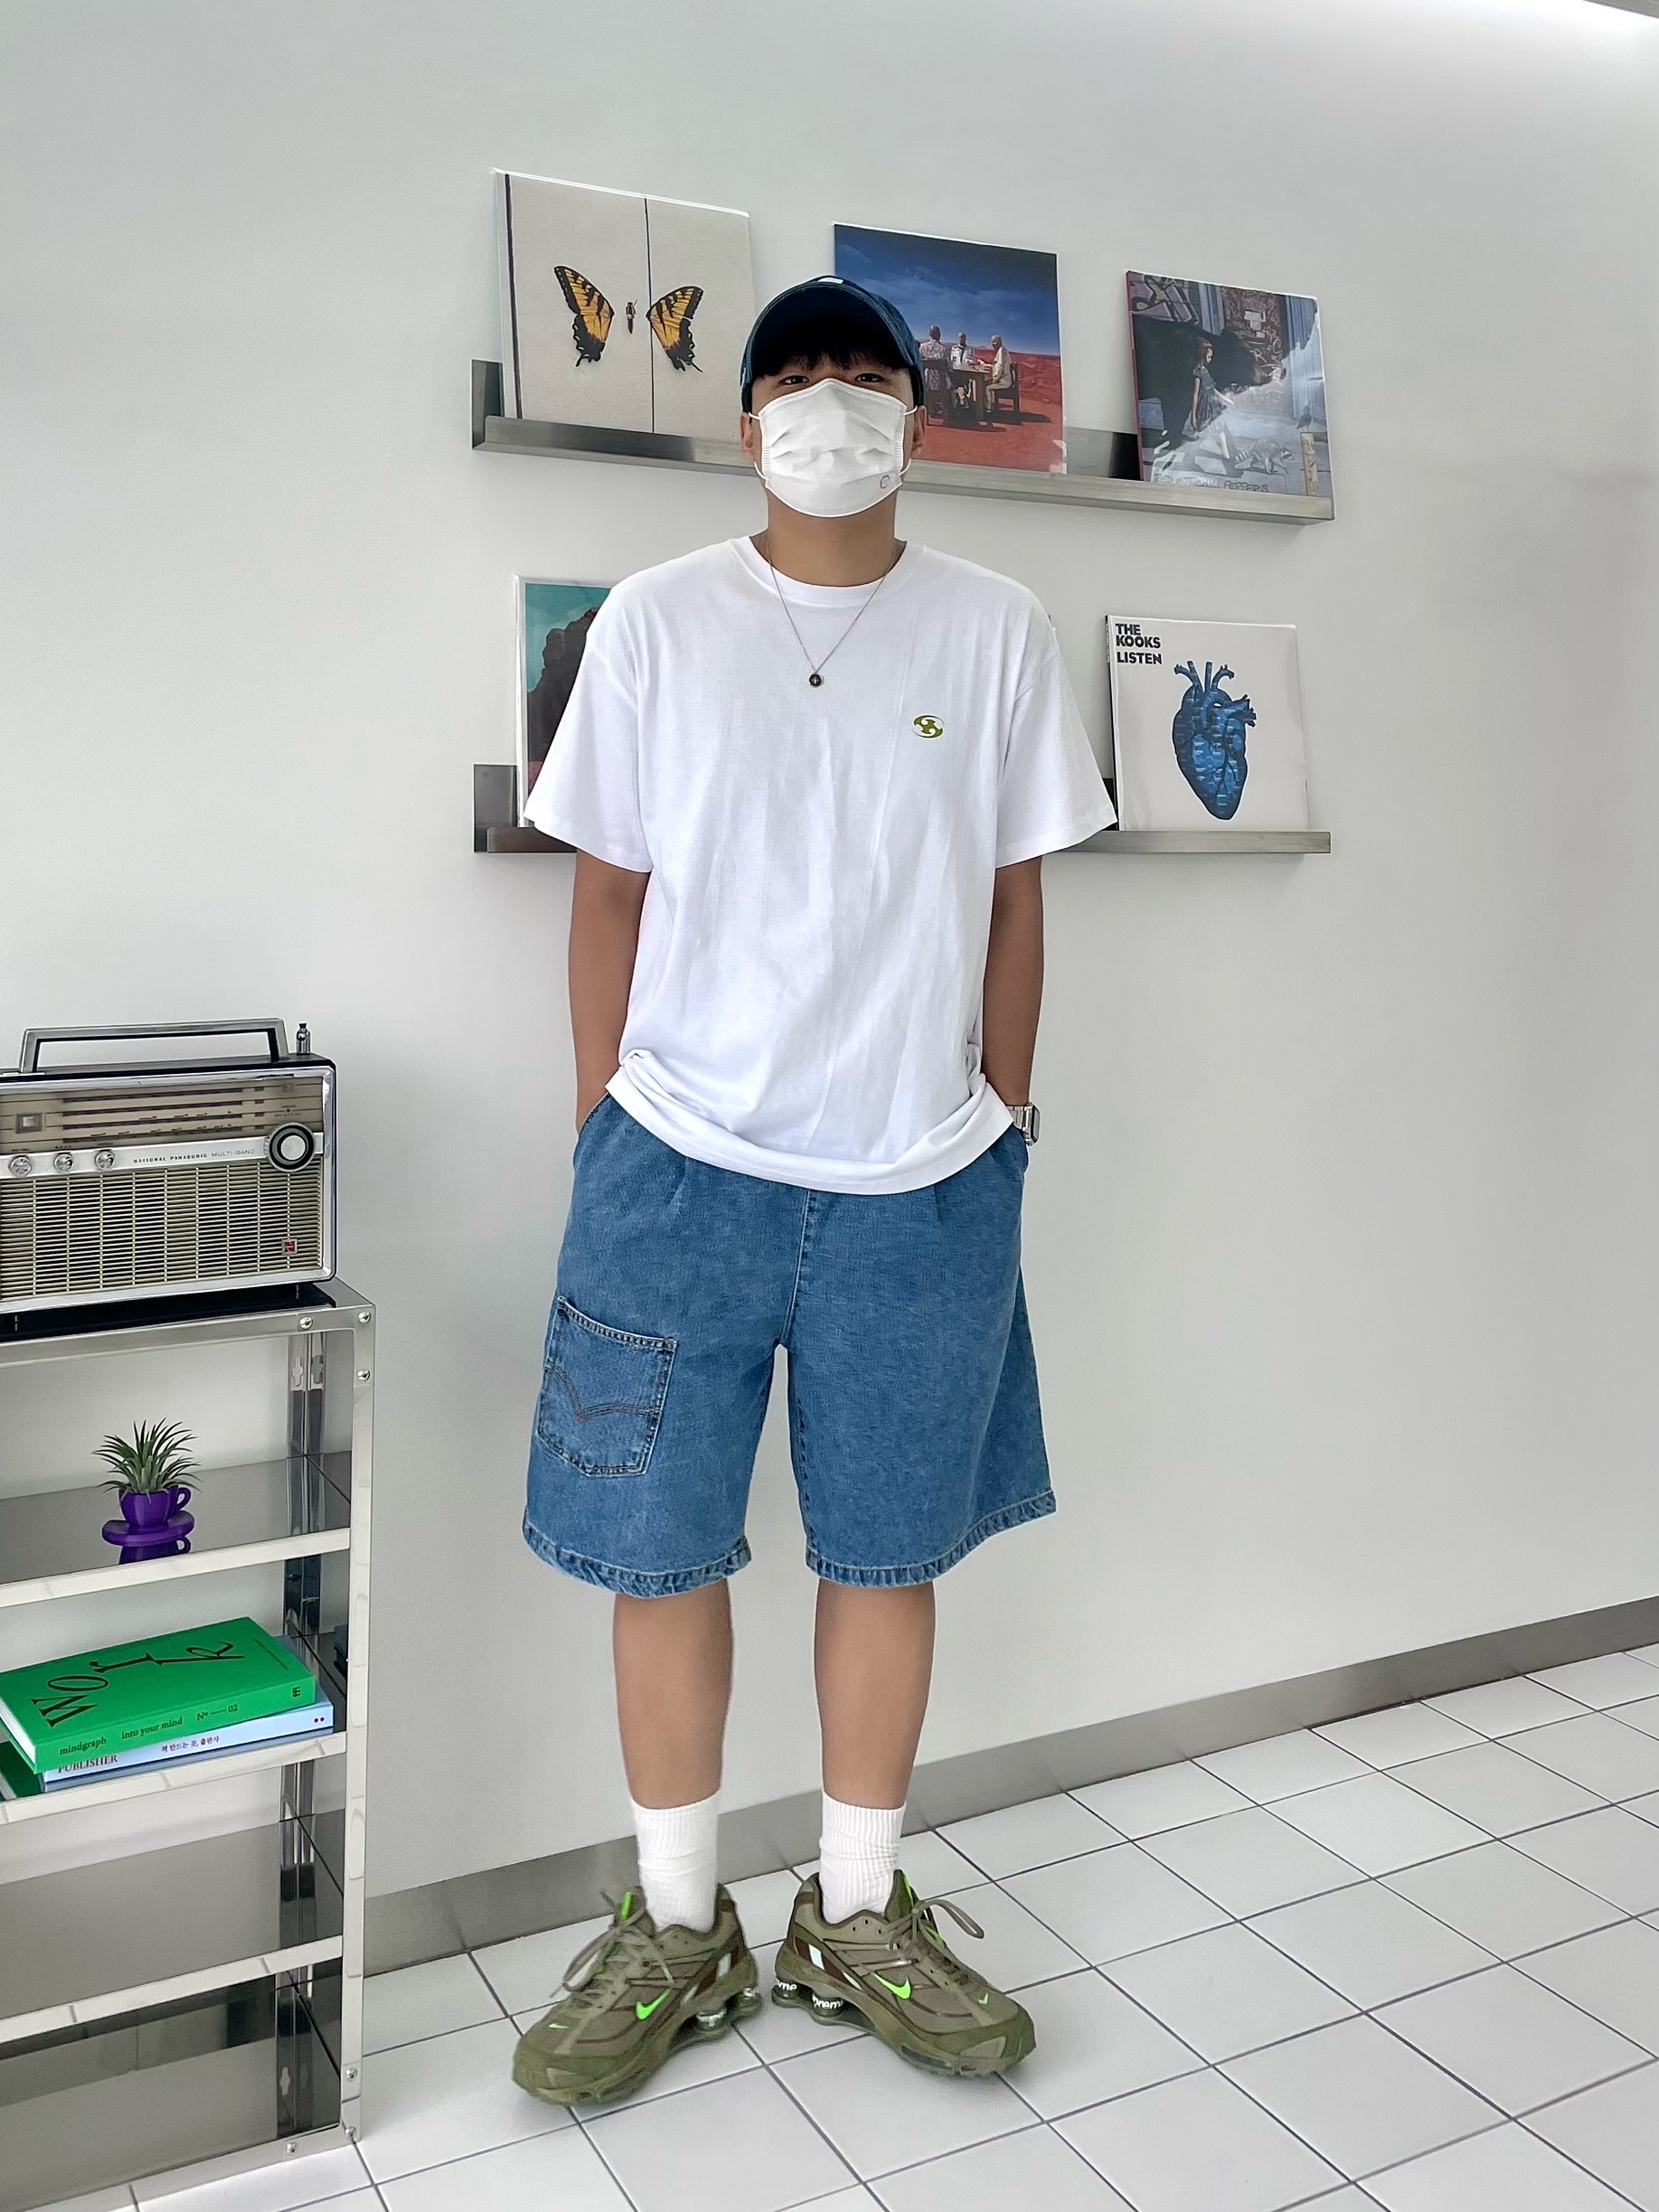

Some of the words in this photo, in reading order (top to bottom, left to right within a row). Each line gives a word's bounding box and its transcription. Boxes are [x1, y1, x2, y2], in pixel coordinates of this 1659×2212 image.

[1115, 623, 1141, 635] THE
[1116, 635, 1161, 649] KOOKS
[1117, 652, 1163, 665] LISTEN
[60, 1737, 107, 1755] mindgraph
[121, 1730, 139, 1740] into
[140, 1725, 159, 1737] your
[161, 1717, 184, 1730] mind
[228, 1704, 239, 1713] 02
[58, 1755, 118, 1774] PUBLISHER
